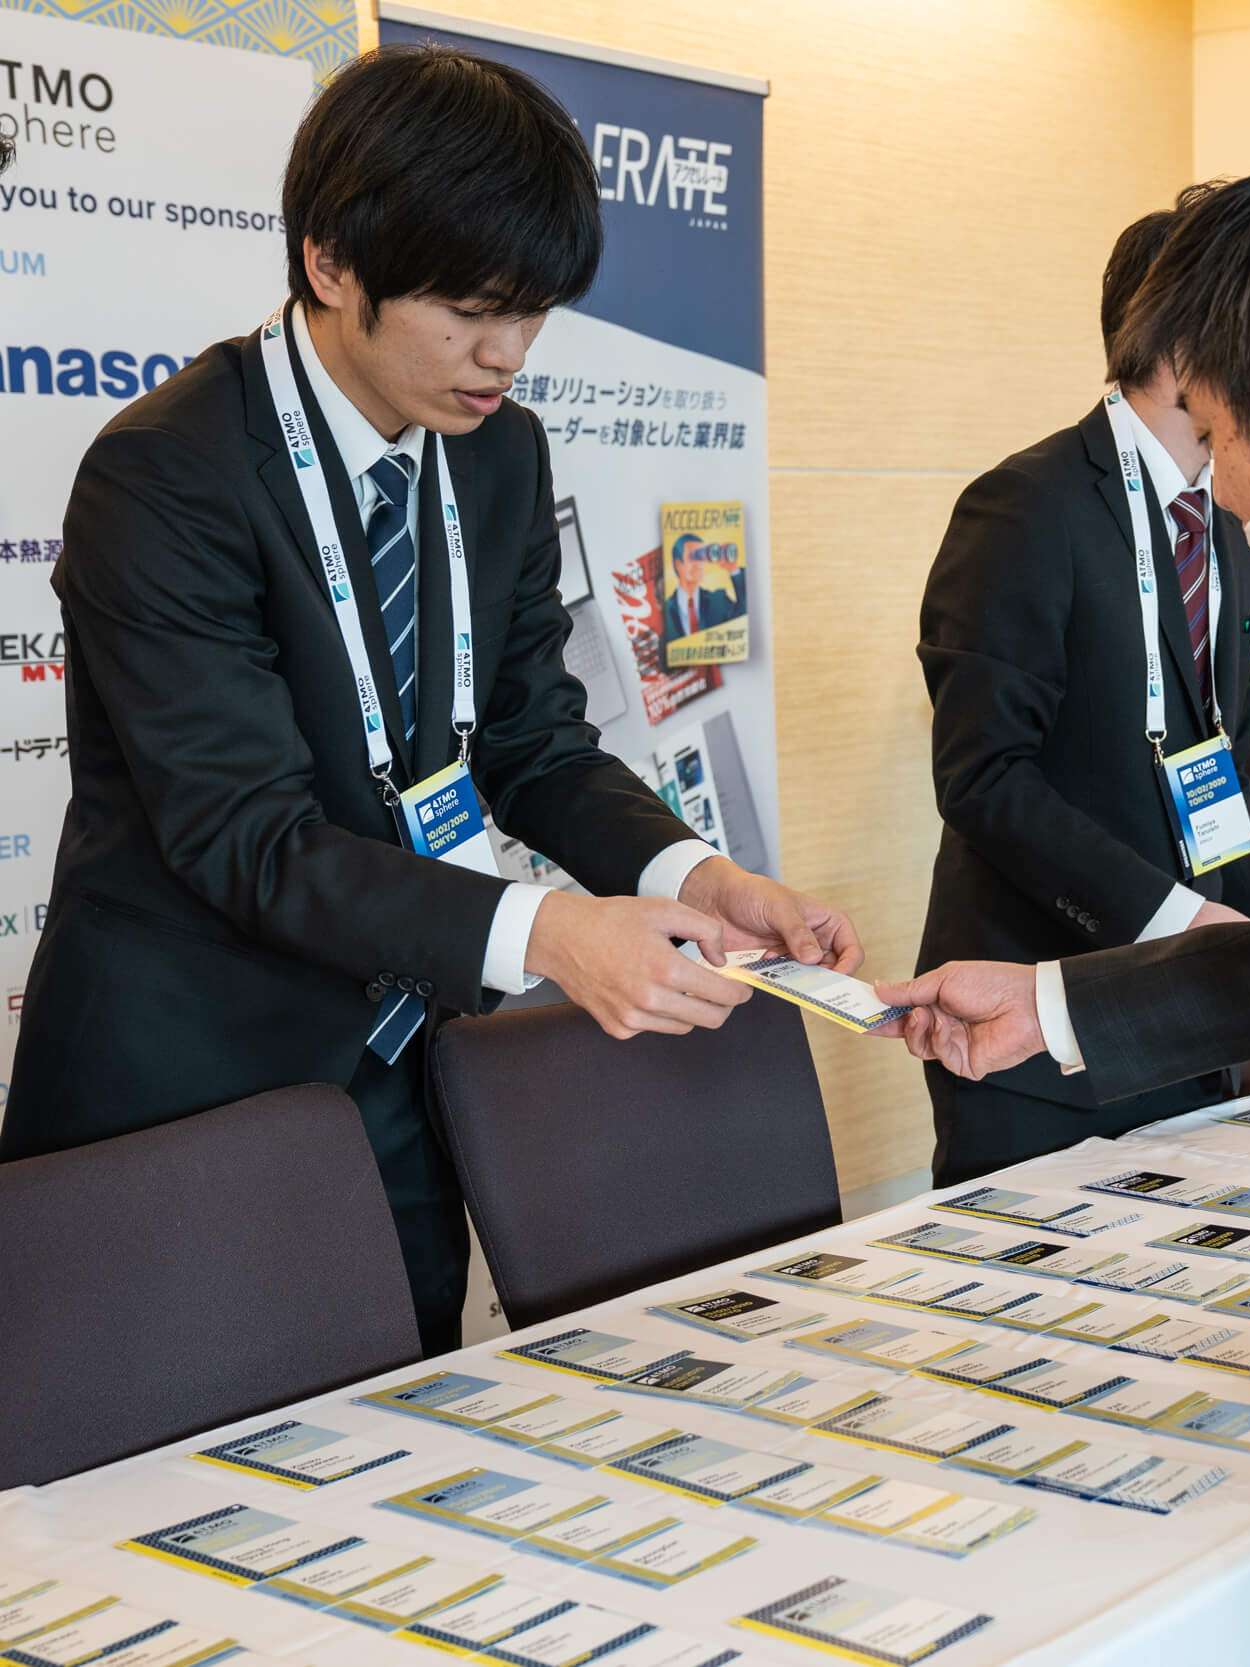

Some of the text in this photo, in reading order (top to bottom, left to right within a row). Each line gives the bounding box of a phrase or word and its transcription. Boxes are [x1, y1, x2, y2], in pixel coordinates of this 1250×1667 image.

[0, 184, 57, 212] you
[67, 186, 97, 214] to
[108, 197, 155, 220] our
[0, 250, 46, 276] UM
[0, 345, 195, 401] naso
[282, 412, 300, 448] ATMO
[293, 410, 311, 446] sphere
[541, 416, 746, 449] ーダーを対象とした業界誌
[452, 523, 463, 559] ATMO
[321, 545, 337, 582] ATMO
[463, 652, 471, 688] ATMO
[1193, 758, 1217, 773] ATMO
[432, 789, 457, 808] ATMO
[434, 798, 460, 818] sphere
[1188, 791, 1215, 807] TOKYO
[426, 811, 470, 842] 10/02/2020
[428, 831, 457, 852] TOKYO
